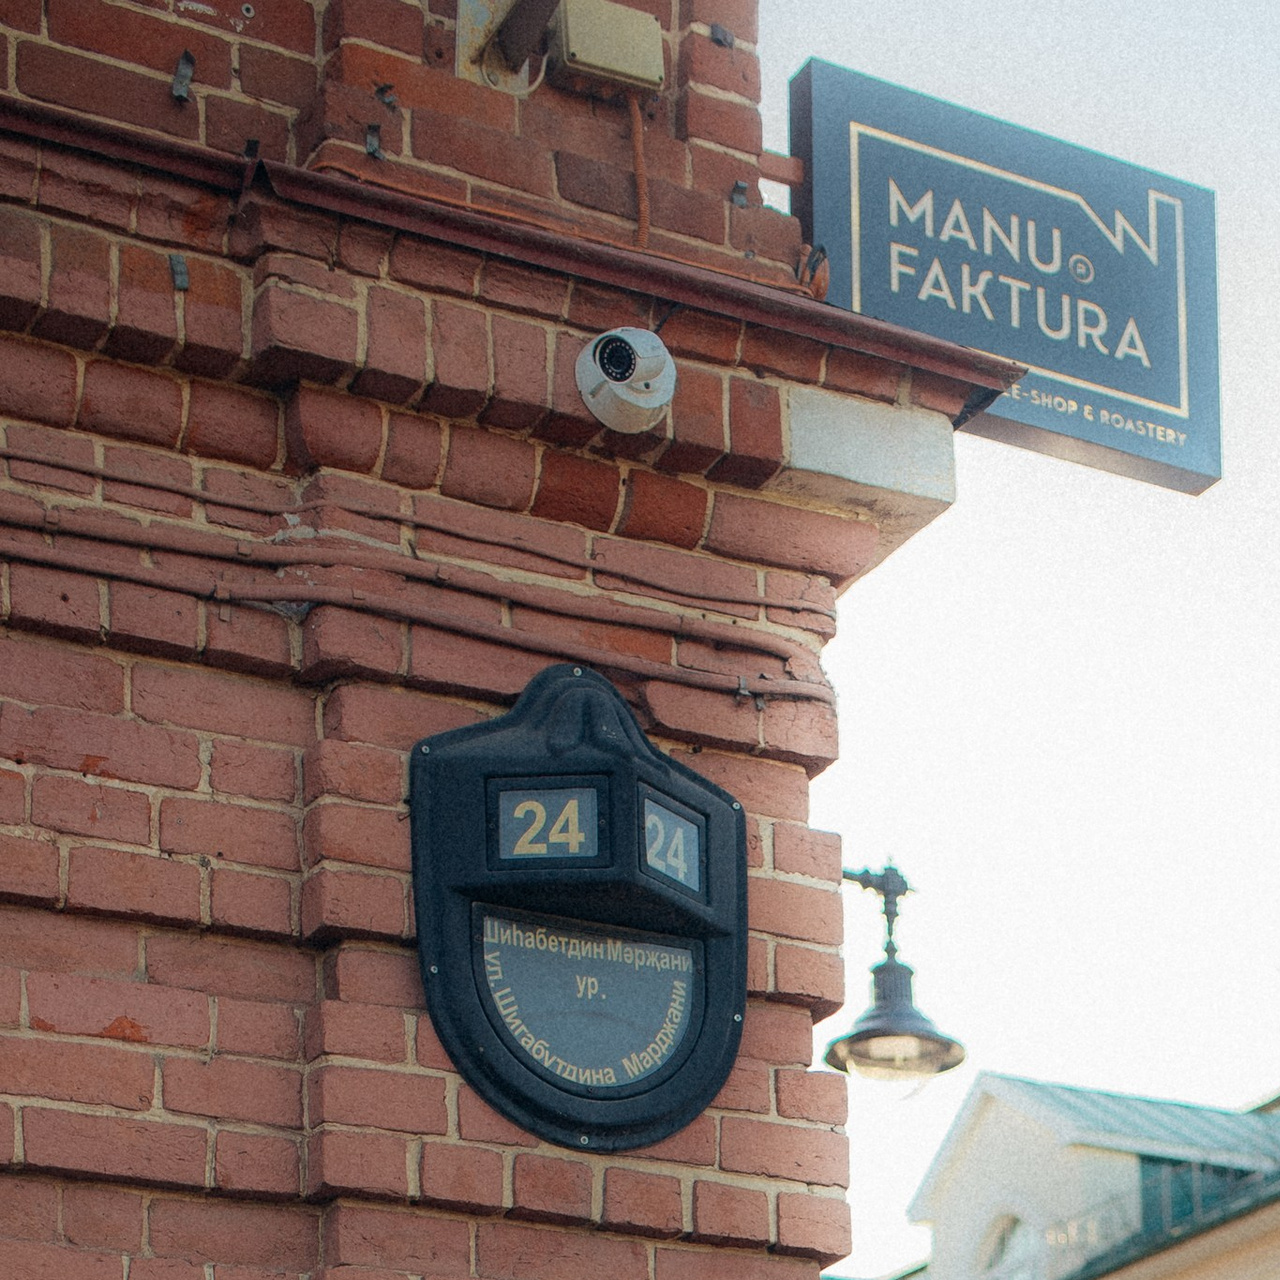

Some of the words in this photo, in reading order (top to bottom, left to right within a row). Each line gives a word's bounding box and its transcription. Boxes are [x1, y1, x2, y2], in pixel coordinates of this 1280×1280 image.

[889, 177, 1061, 275] MANU
[889, 241, 1151, 369] FAKTURA
[1099, 409, 1188, 447] ROASTERY
[512, 799, 586, 855] 24
[645, 814, 688, 882] 24
[493, 986, 617, 1086] Шигабутдина
[621, 979, 687, 1079] Марджани
